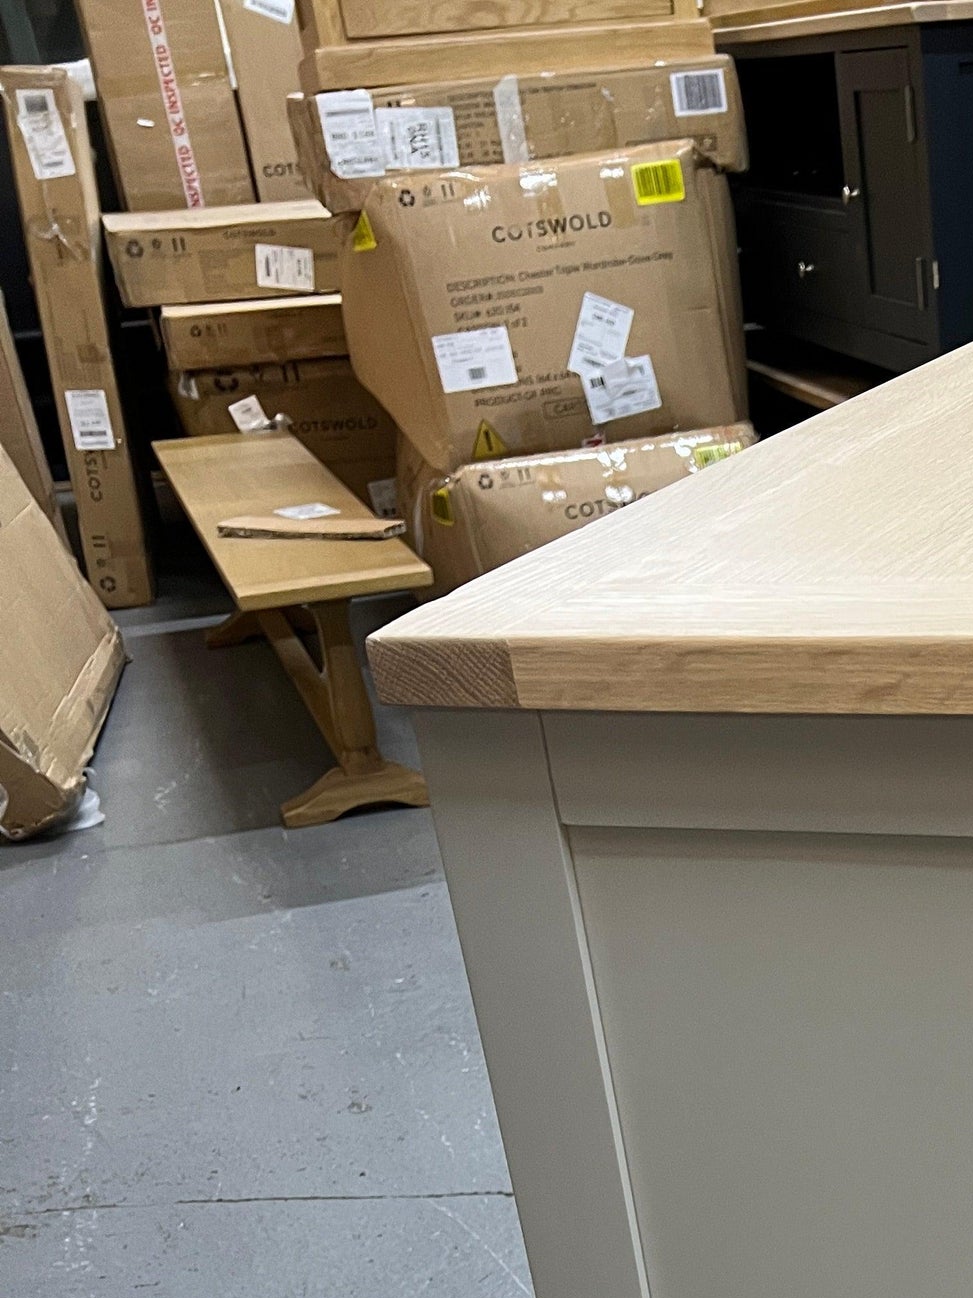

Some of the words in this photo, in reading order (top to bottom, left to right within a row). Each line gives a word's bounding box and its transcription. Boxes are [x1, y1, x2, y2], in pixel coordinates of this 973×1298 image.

[155, 44, 180, 114] INSPECTED
[178, 145, 201, 208] NSPECTED
[491, 211, 613, 243] COTSWOLD
[84, 450, 103, 502] COTS
